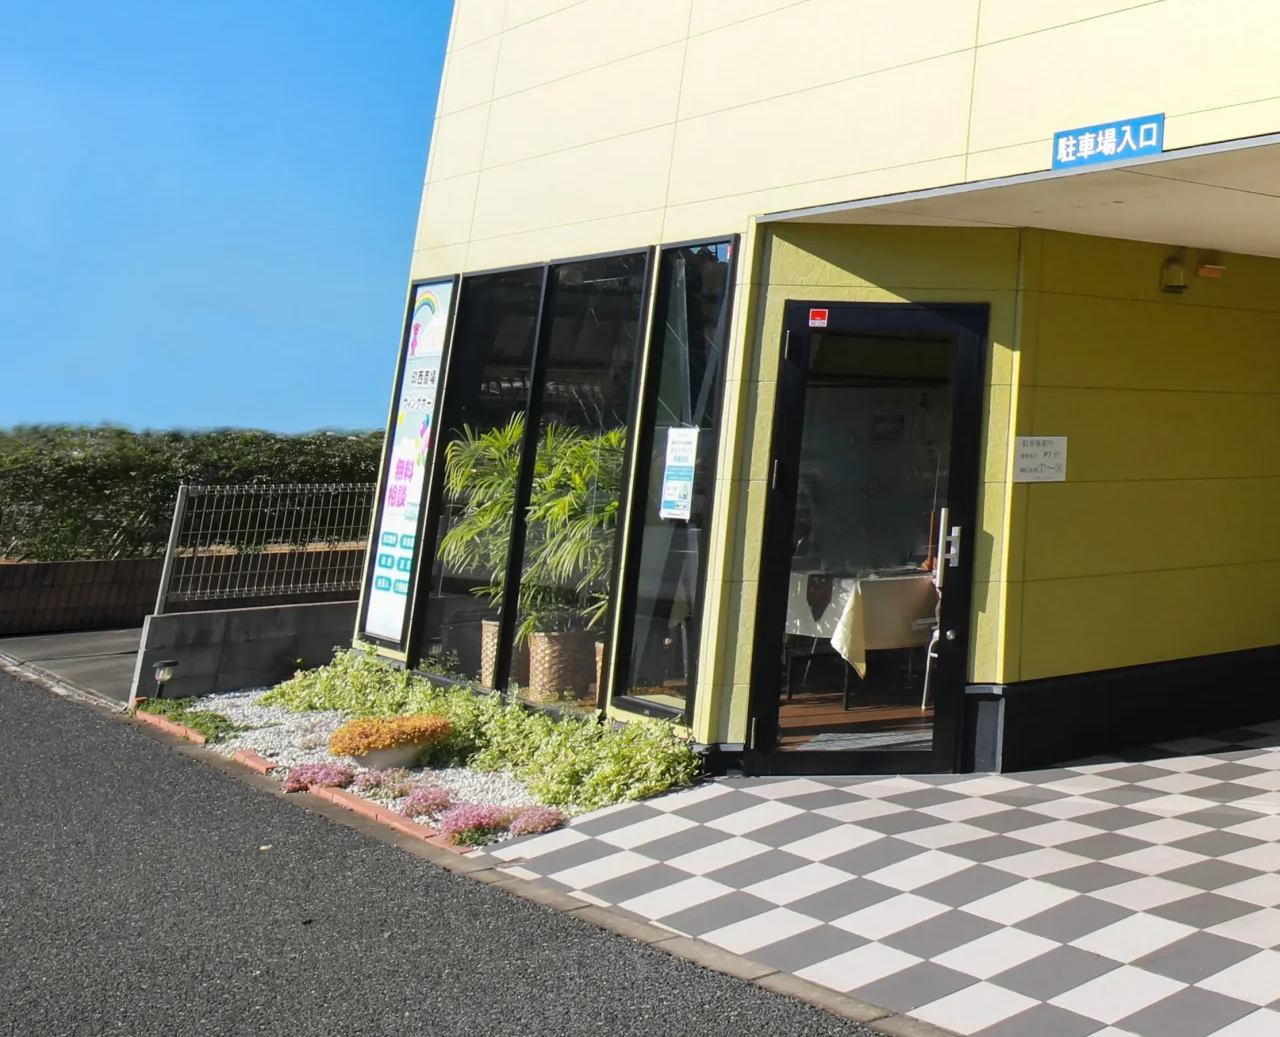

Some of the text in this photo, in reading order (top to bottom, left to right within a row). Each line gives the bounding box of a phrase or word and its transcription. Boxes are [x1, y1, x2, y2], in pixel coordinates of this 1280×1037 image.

[1057, 123, 1157, 163] 駐車場入口
